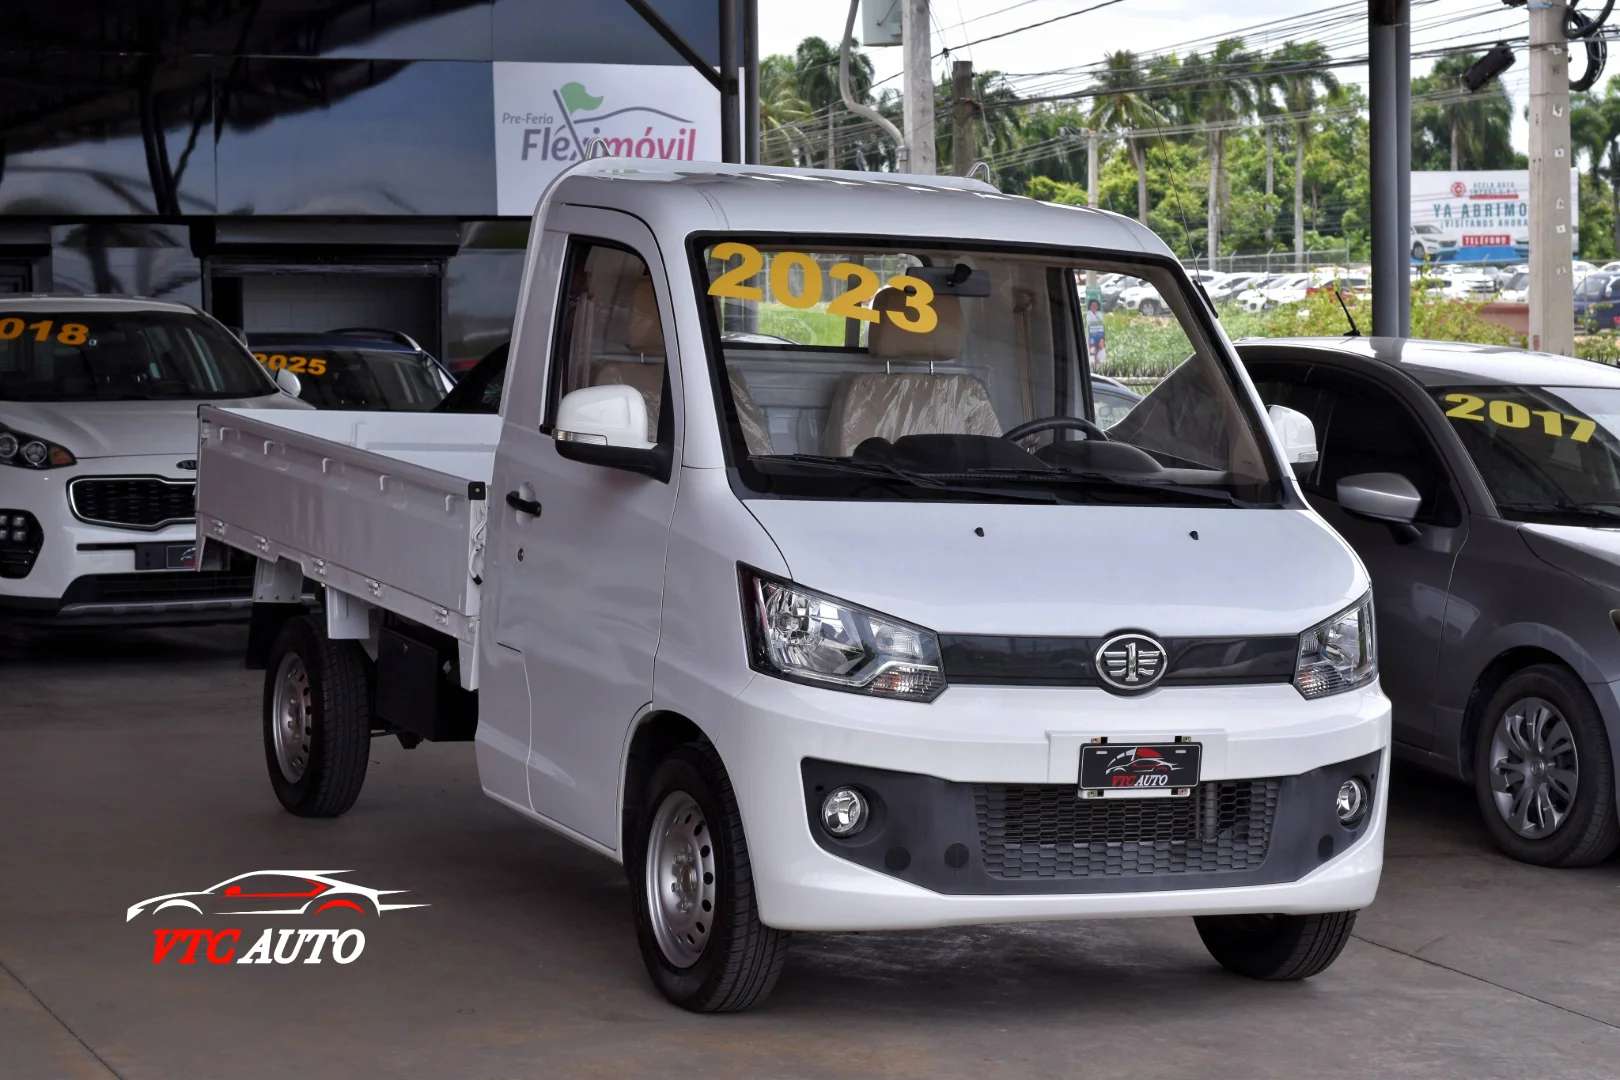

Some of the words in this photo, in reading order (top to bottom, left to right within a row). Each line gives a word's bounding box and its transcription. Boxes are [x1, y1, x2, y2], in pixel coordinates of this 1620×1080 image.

[502, 112, 554, 125] Pre-Feria
[1433, 203, 1451, 218] YA
[1462, 202, 1527, 218] ABRIMO
[707, 242, 938, 334] 2023
[0, 317, 89, 346] 018
[1445, 393, 1597, 443] 2017
[1135, 774, 1169, 787] AUTO
